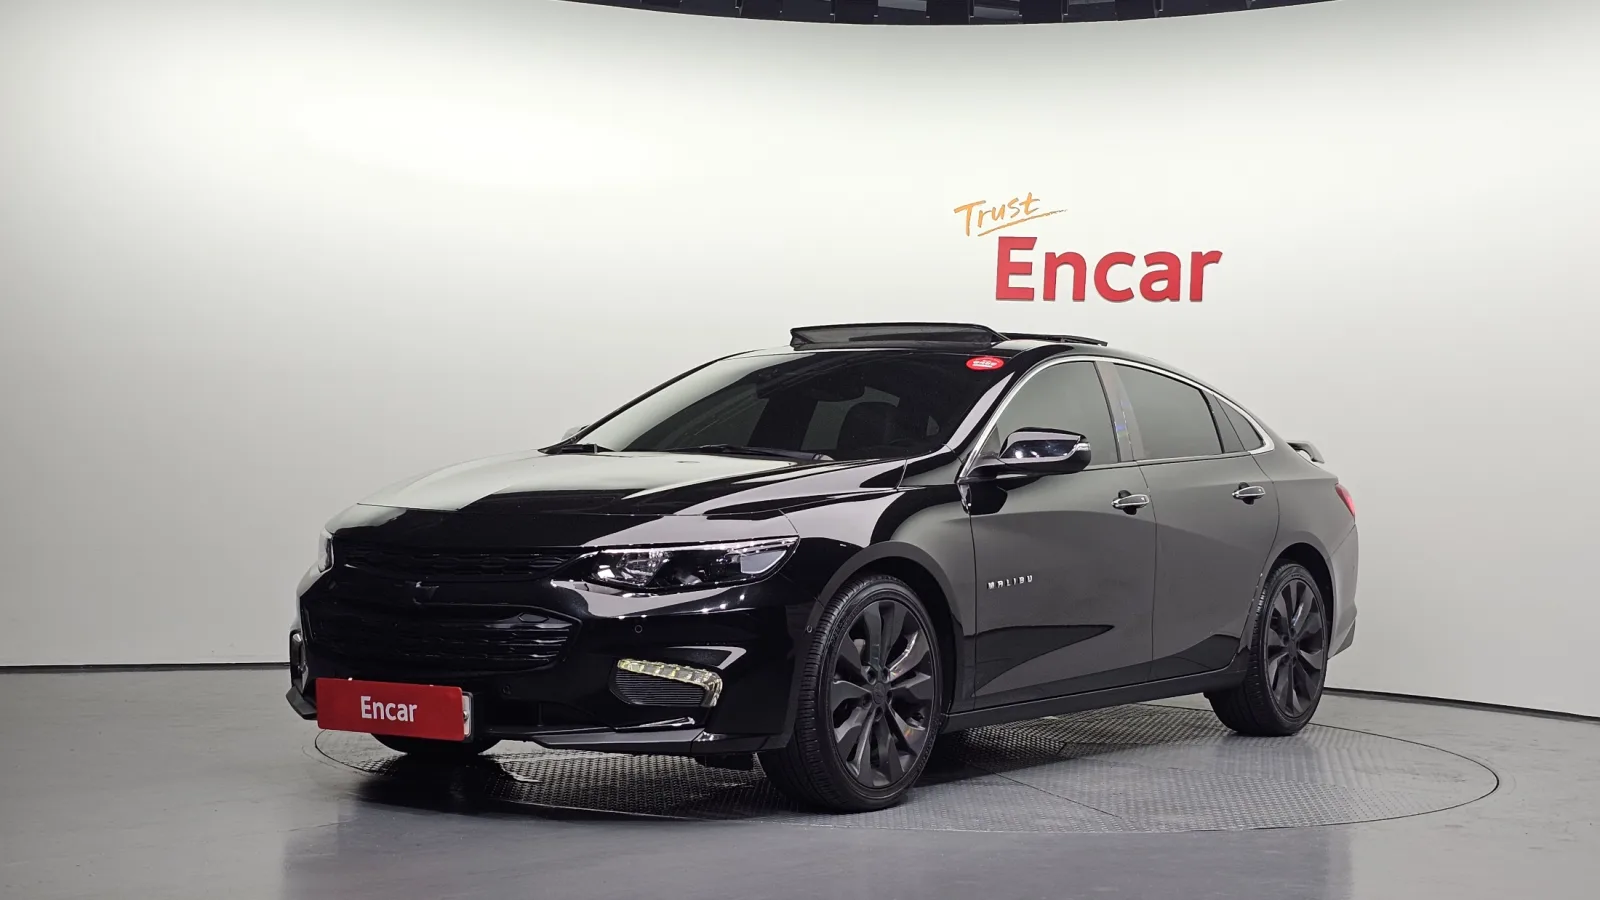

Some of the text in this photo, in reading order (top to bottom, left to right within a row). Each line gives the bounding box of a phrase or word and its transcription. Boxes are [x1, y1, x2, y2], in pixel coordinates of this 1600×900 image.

[953, 192, 1042, 237] Trust
[995, 236, 1223, 303] Encar
[987, 574, 1033, 590] MALIBU
[360, 695, 418, 722] Encar
